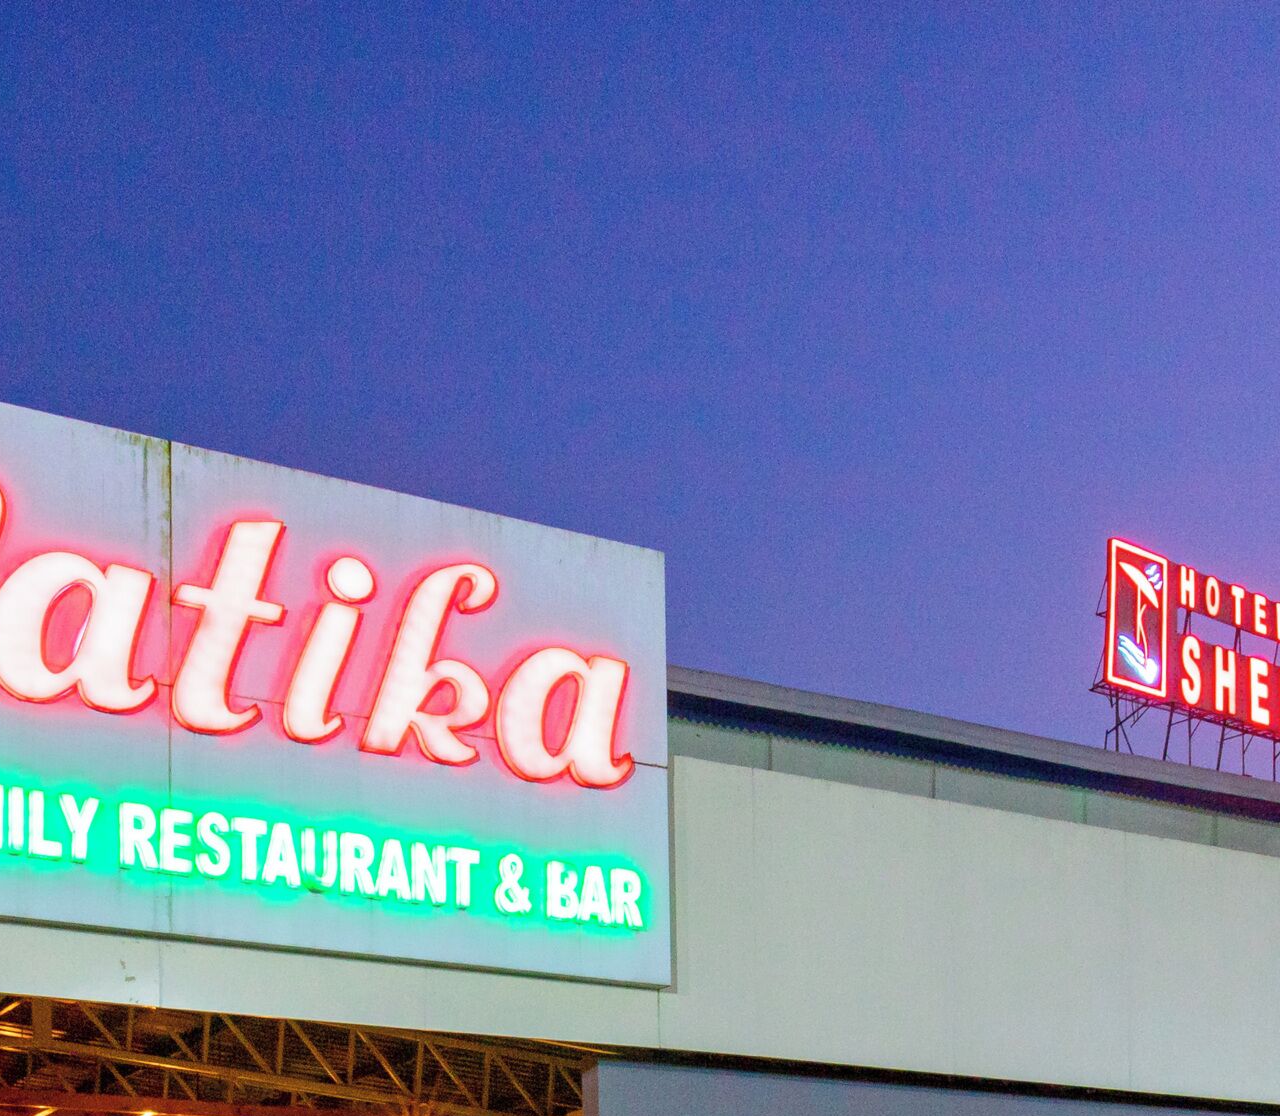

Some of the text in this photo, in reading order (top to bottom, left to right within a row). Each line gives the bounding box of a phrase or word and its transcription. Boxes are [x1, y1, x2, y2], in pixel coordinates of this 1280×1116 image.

[119, 801, 480, 910] RESTAURANT
[493, 852, 532, 915] &
[546, 859, 644, 931] BAR
